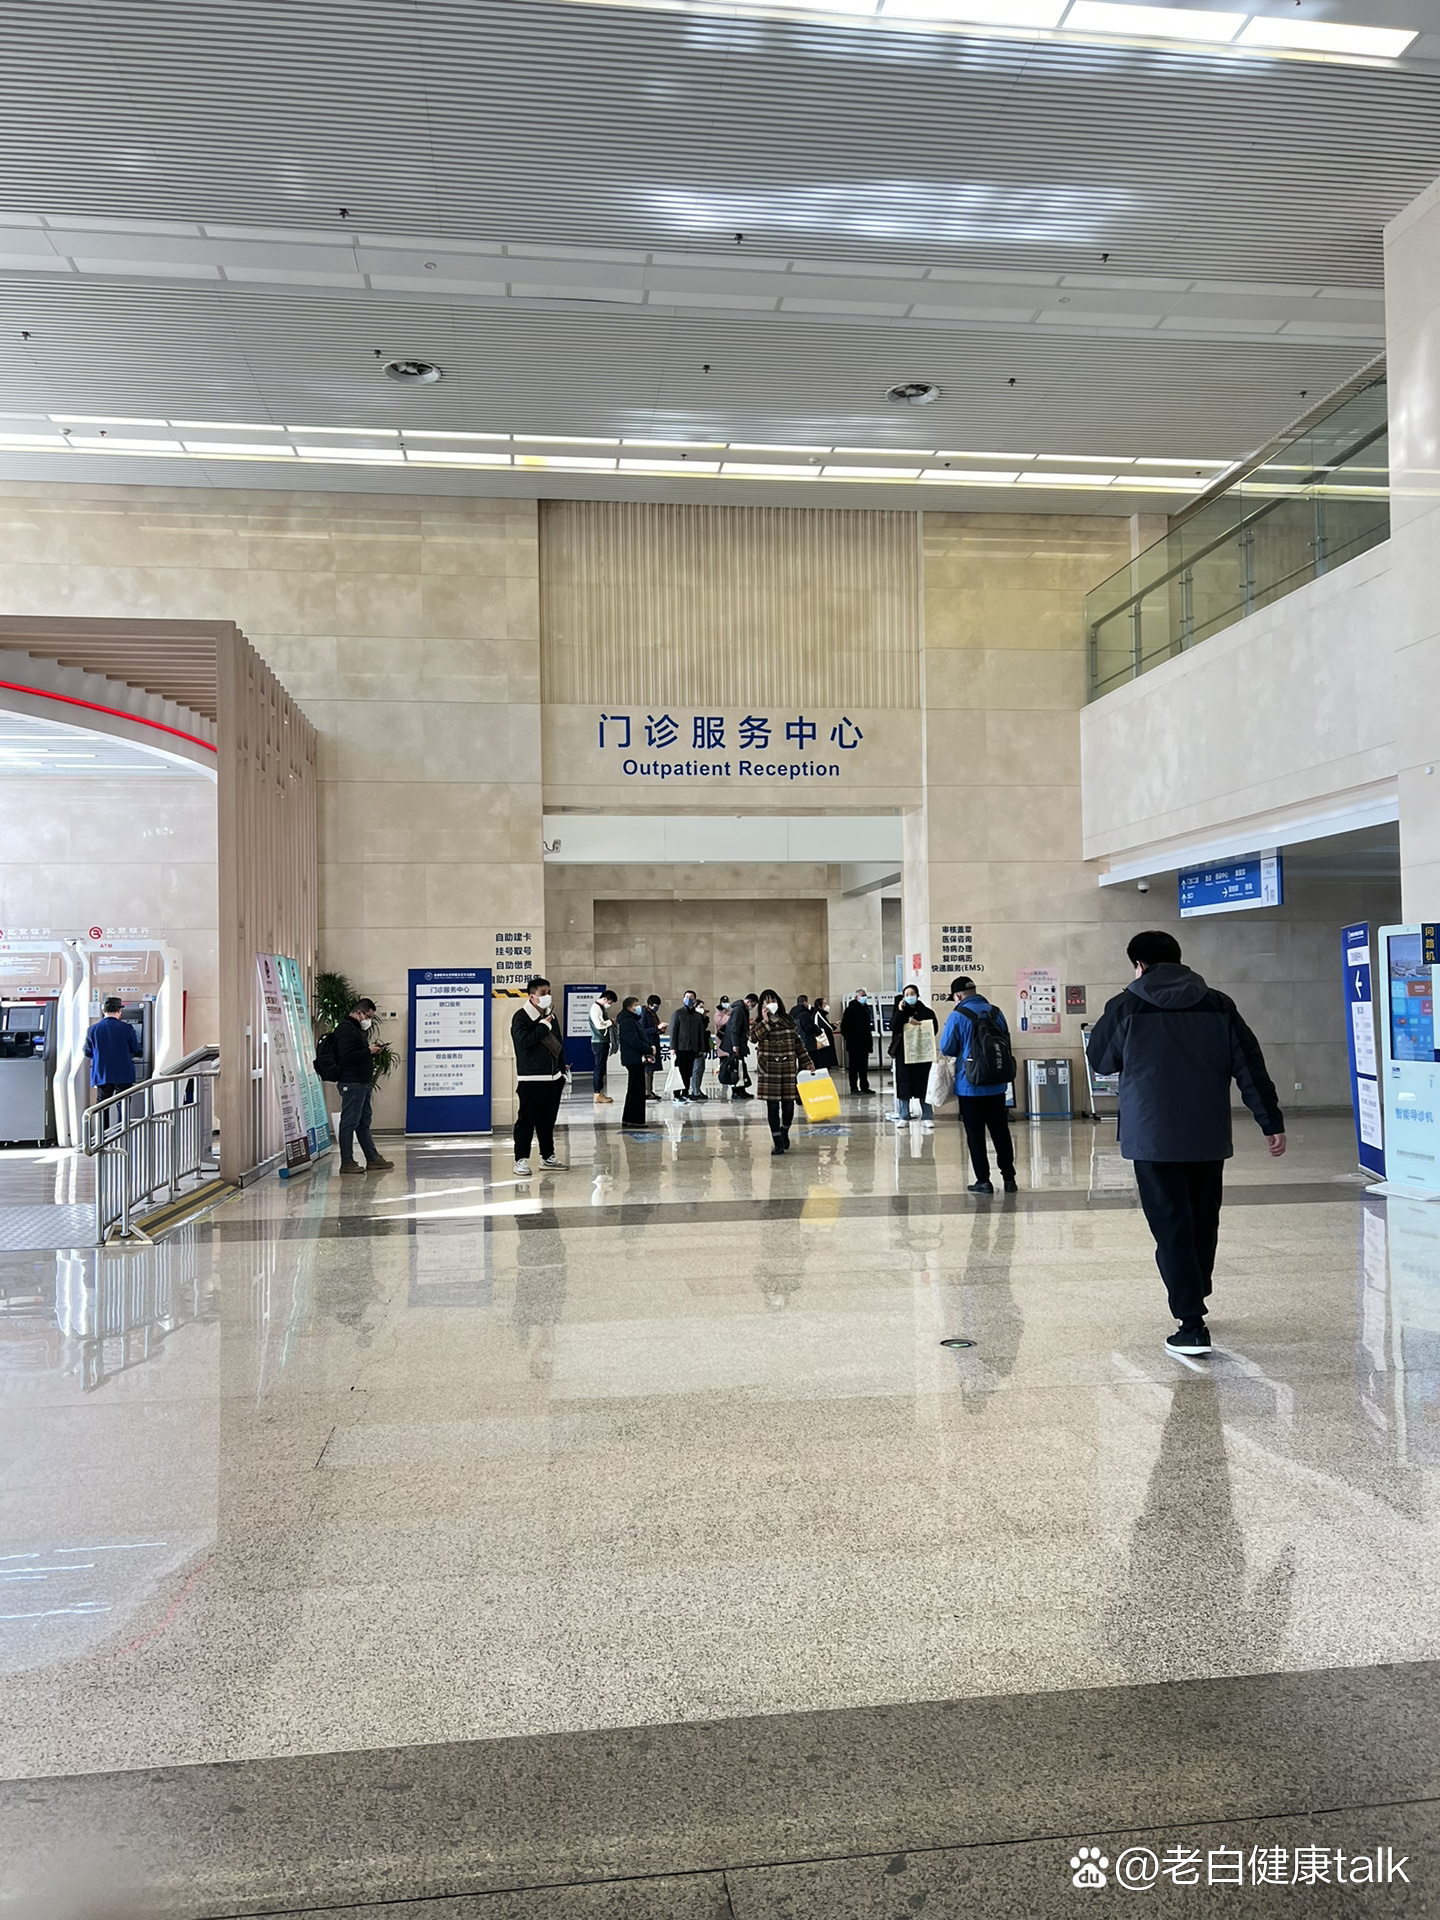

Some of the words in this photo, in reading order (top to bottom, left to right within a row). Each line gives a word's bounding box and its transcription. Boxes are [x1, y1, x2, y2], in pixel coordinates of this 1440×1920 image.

[598, 713, 865, 750] 门诊服务中心
[622, 759, 732, 780] Outpatient
[738, 759, 841, 781] Reception
[7, 928, 52, 936] 北京银行
[106, 927, 150, 935] 北京银行
[942, 925, 972, 934] 审核盖章
[495, 932, 532, 942] 自助建卡
[942, 935, 972, 943] 医保咨询
[1425, 926, 1436, 961] 问路机
[495, 946, 533, 956] 挂号取号
[942, 945, 973, 953] 特病办理
[942, 955, 973, 963] 复印病历
[496, 960, 533, 970] 自助缴费
[931, 964, 985, 972] 快递服务(EMS)
[430, 986, 470, 994] 门诊服务中心
[1395, 1107, 1434, 1123] 智能导诊机
